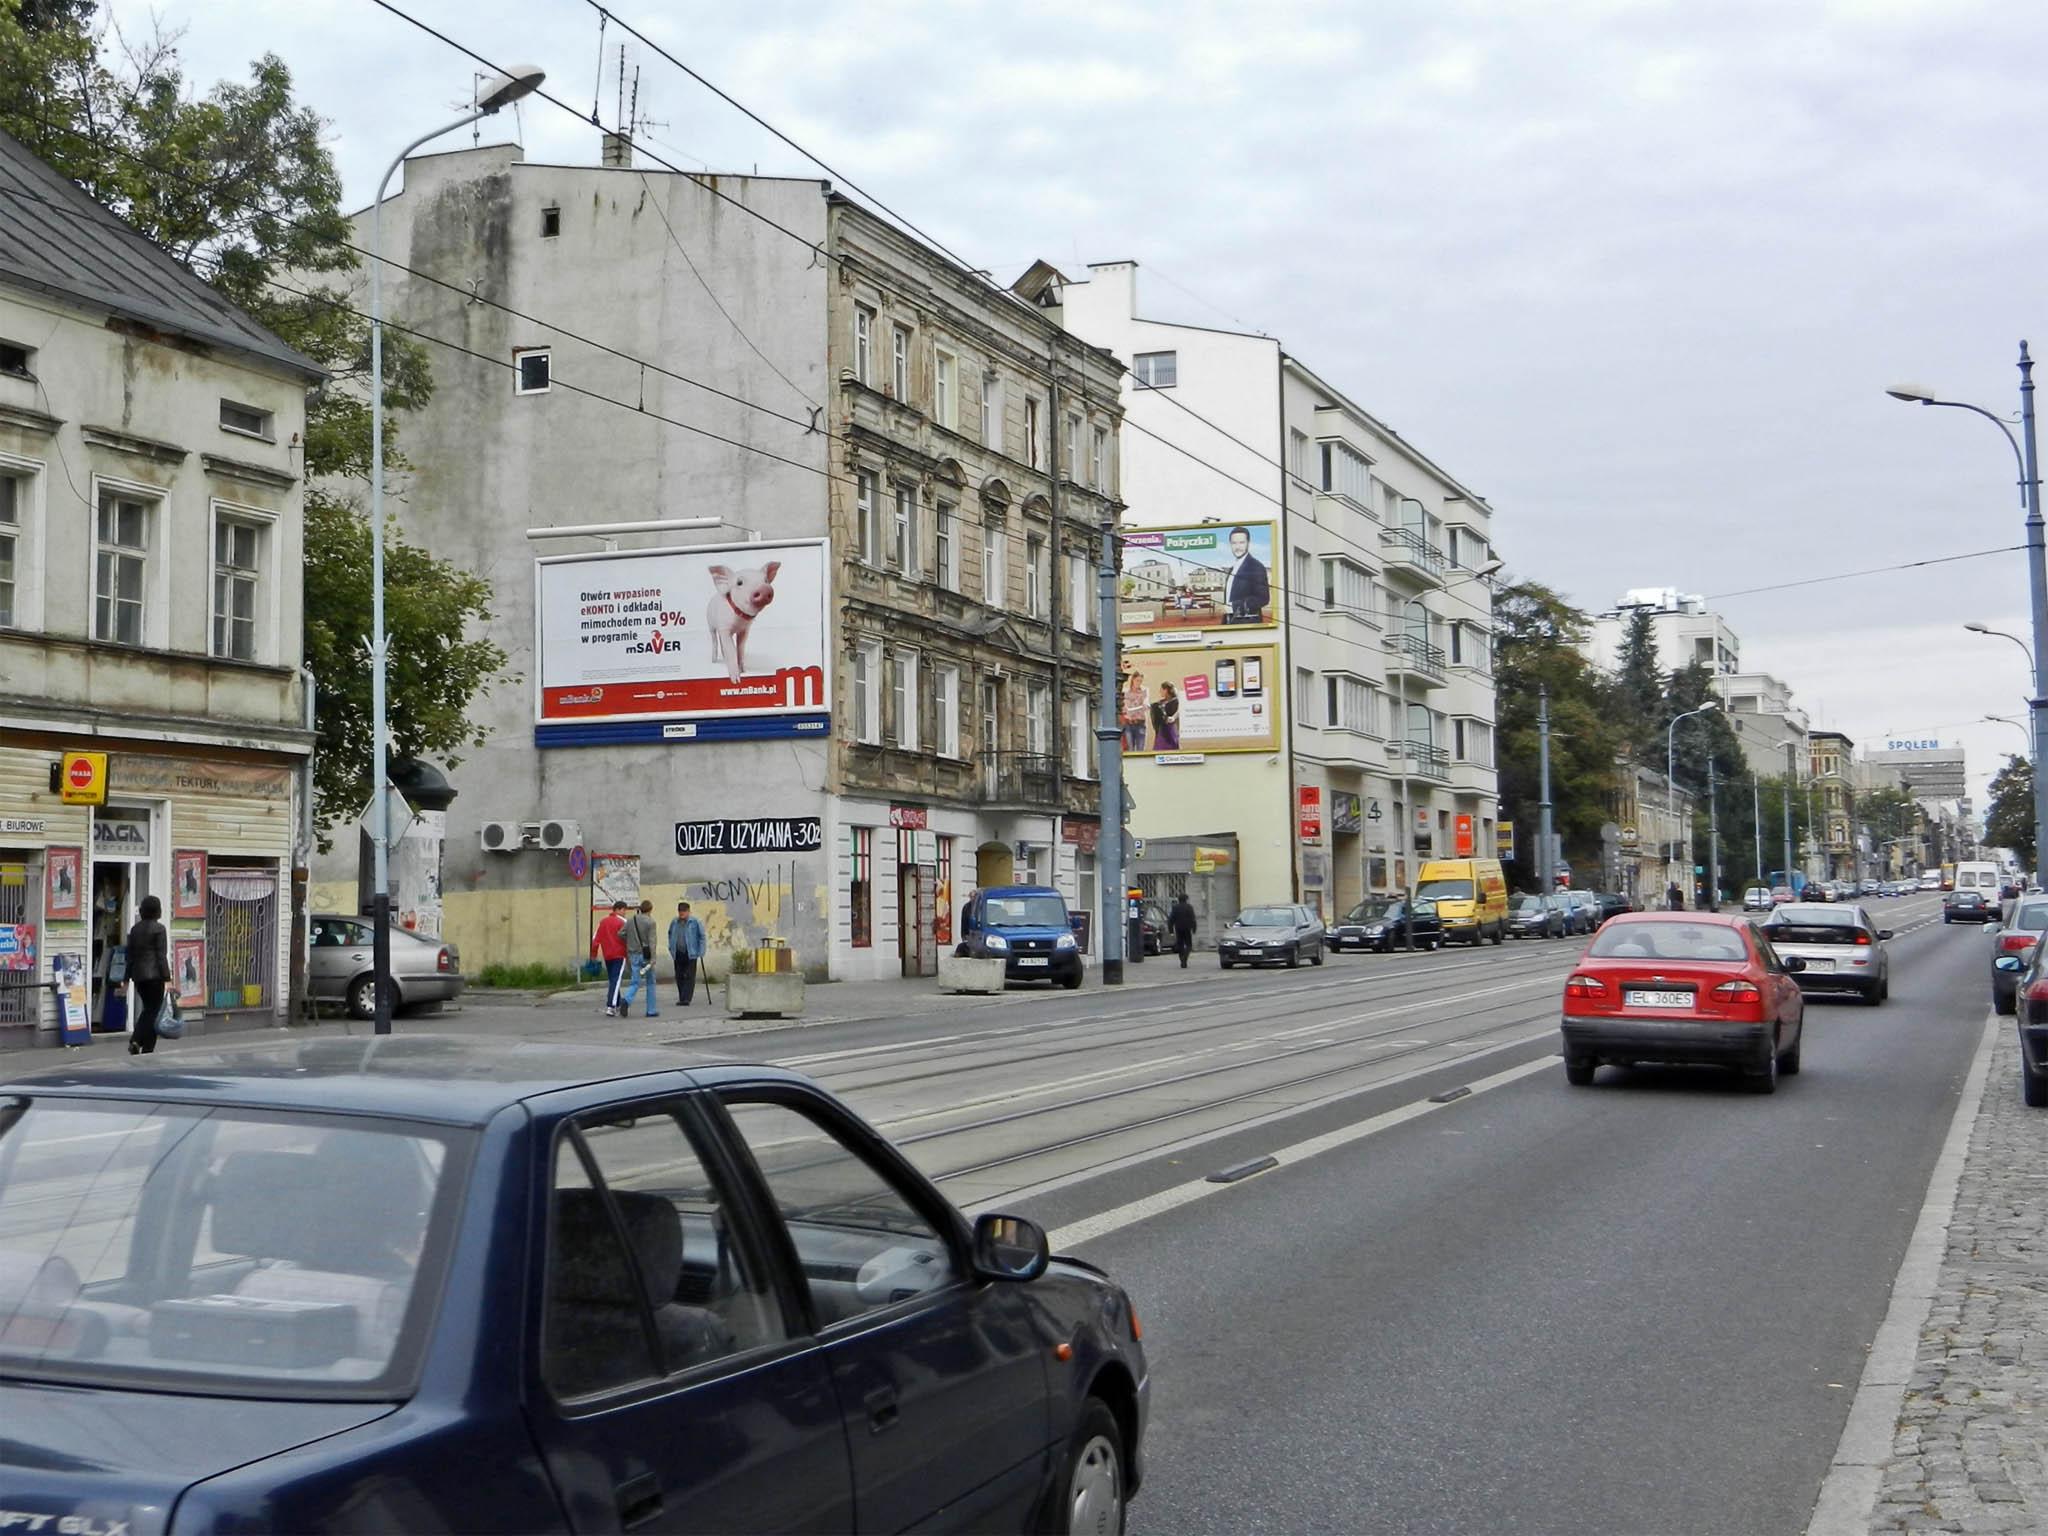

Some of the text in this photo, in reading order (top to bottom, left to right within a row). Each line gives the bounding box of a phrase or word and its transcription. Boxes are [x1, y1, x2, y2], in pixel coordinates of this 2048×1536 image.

[1166, 535, 1214, 549] Pożyczka!
[580, 588, 662, 602] Otwórz wypasione
[580, 600, 663, 616] eKONTO i odkładaj
[581, 611, 686, 630] mimochodem na 9%
[581, 630, 639, 644] w programie
[626, 638, 681, 655] mSAVER
[720, 684, 777, 696] www.mBank.pl
[6, 820, 44, 831] BIUROWE
[677, 820, 724, 851] ODZIEŻ
[1632, 992, 1692, 1004] EL 360ES
